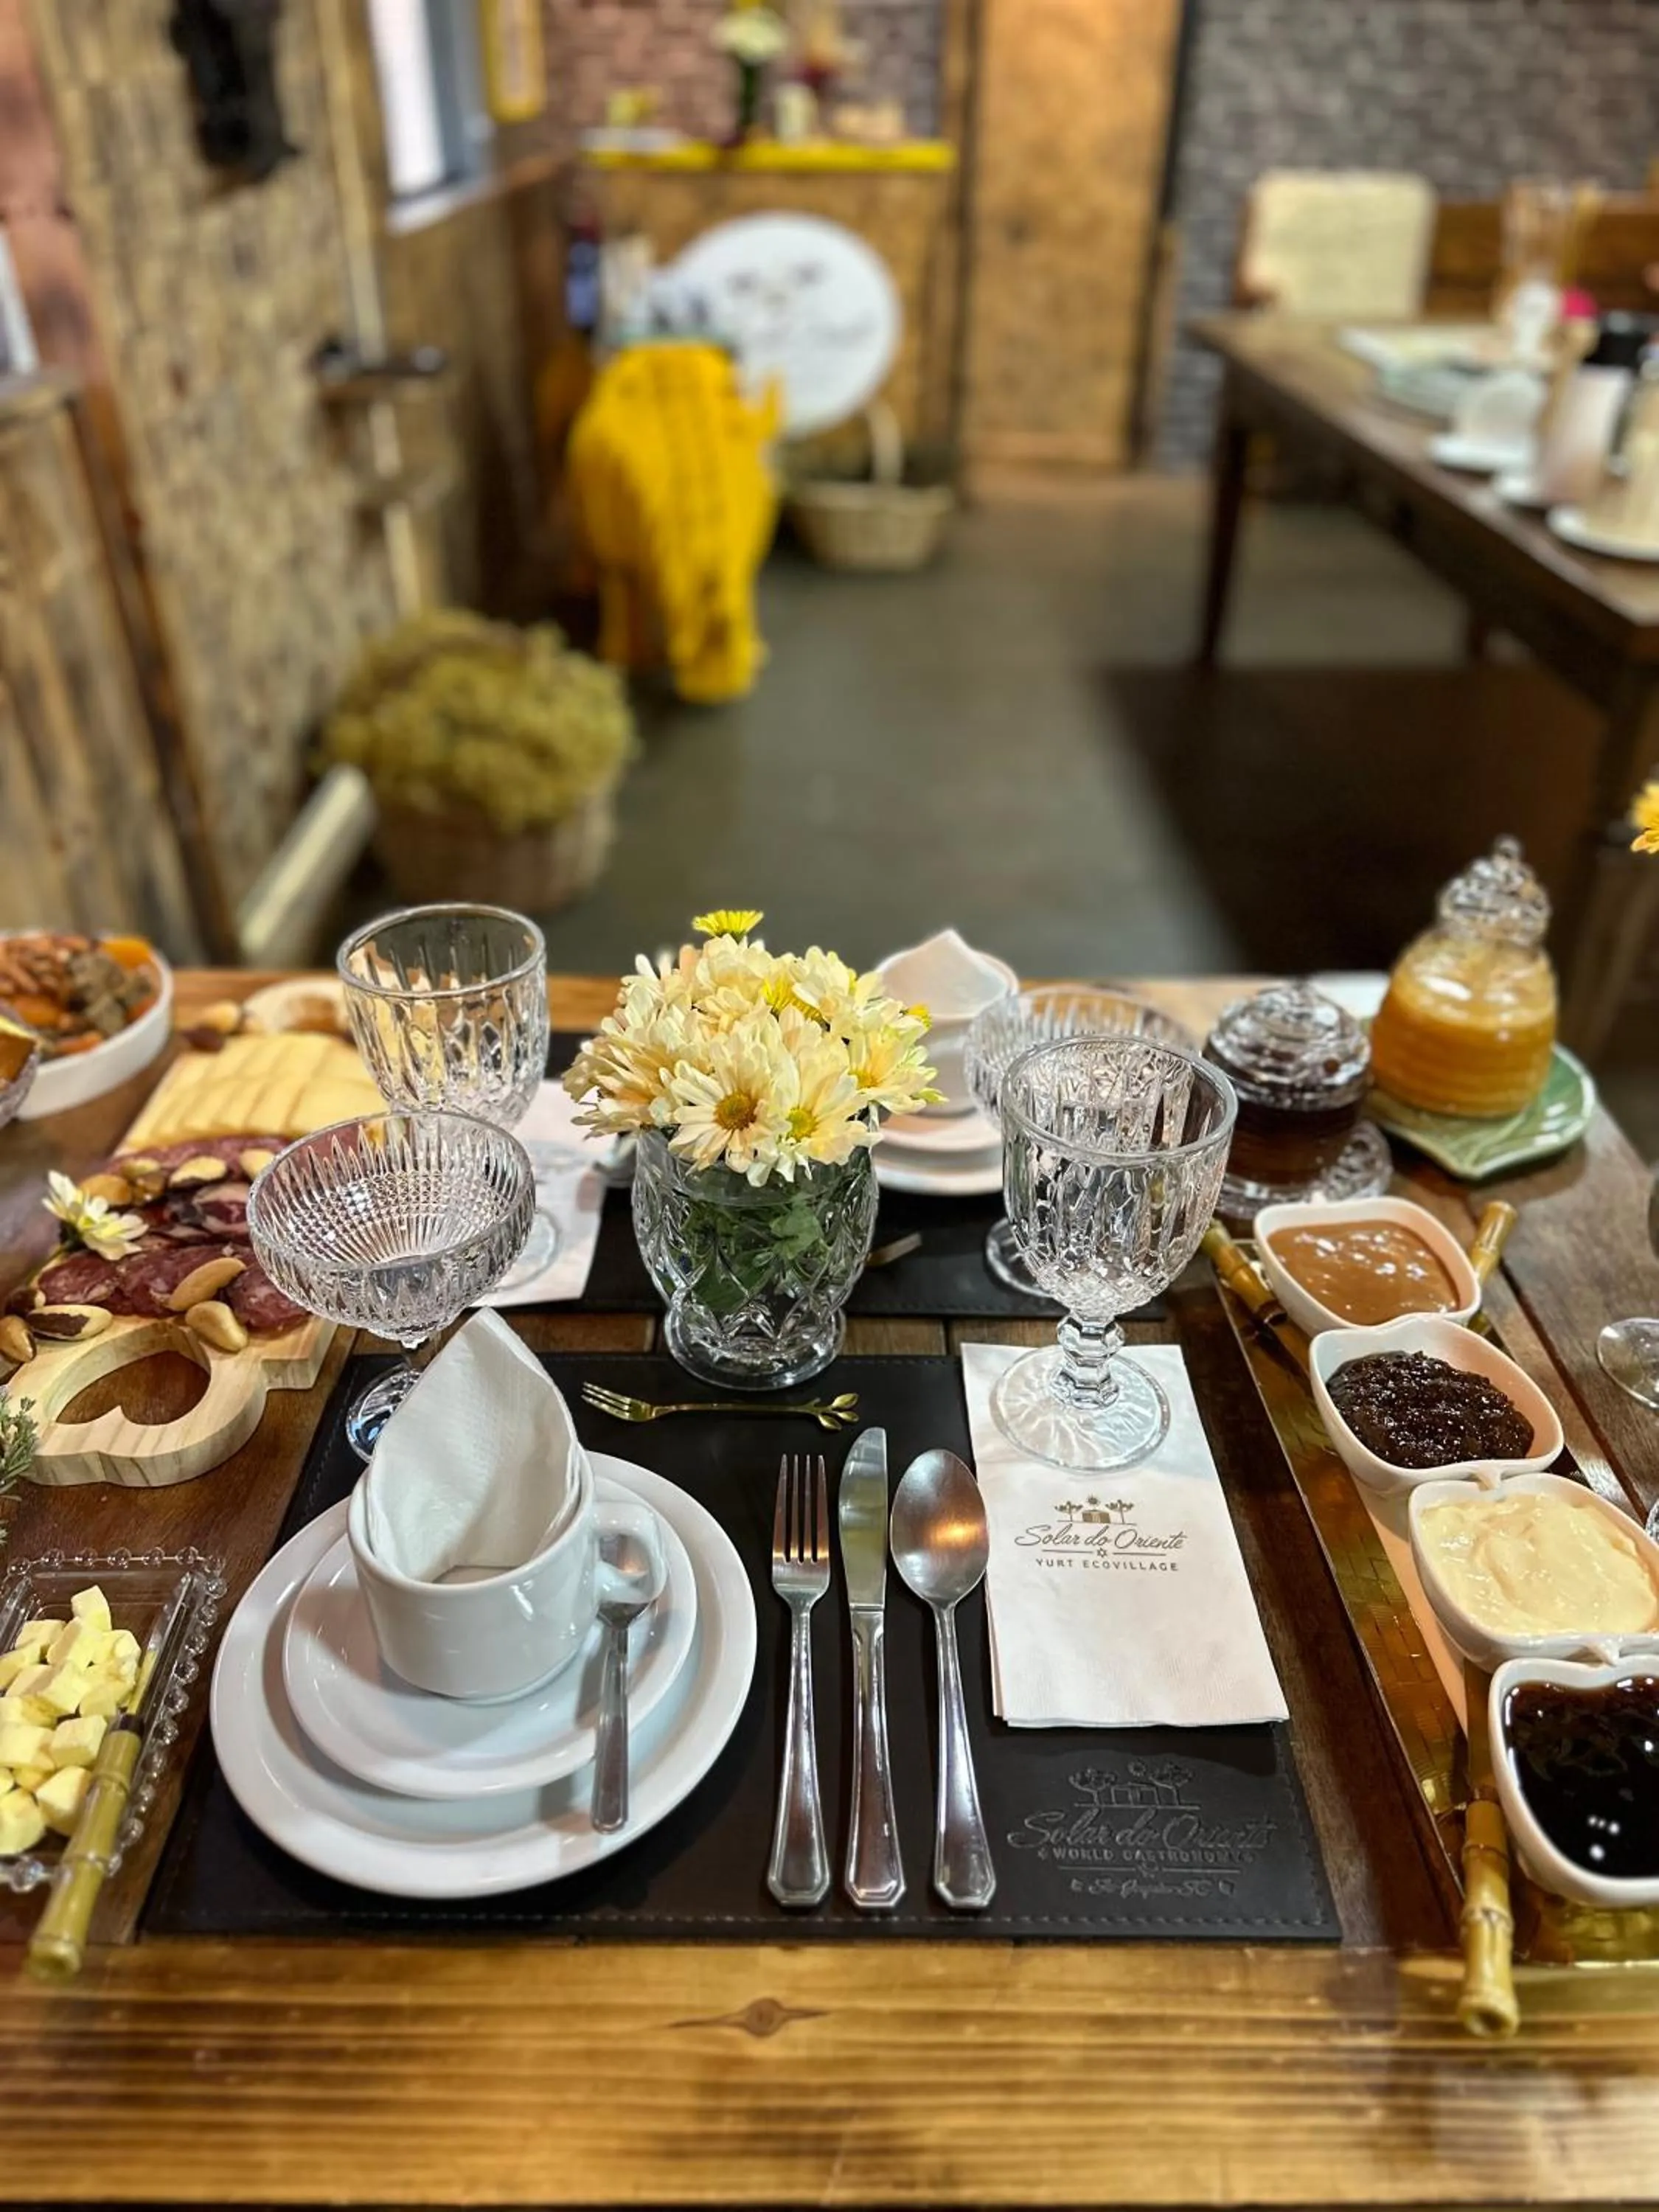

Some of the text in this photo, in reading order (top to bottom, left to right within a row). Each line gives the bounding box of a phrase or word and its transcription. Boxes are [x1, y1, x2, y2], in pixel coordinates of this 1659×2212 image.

[1015, 1523, 1188, 1549] Solar do Oriente
[1035, 1558, 1178, 1571] YURT ECOVILLAGE
[1007, 1807, 1109, 1848] Solar
[1116, 1807, 1161, 1845] do
[1053, 1847, 1113, 1860] WORLD
